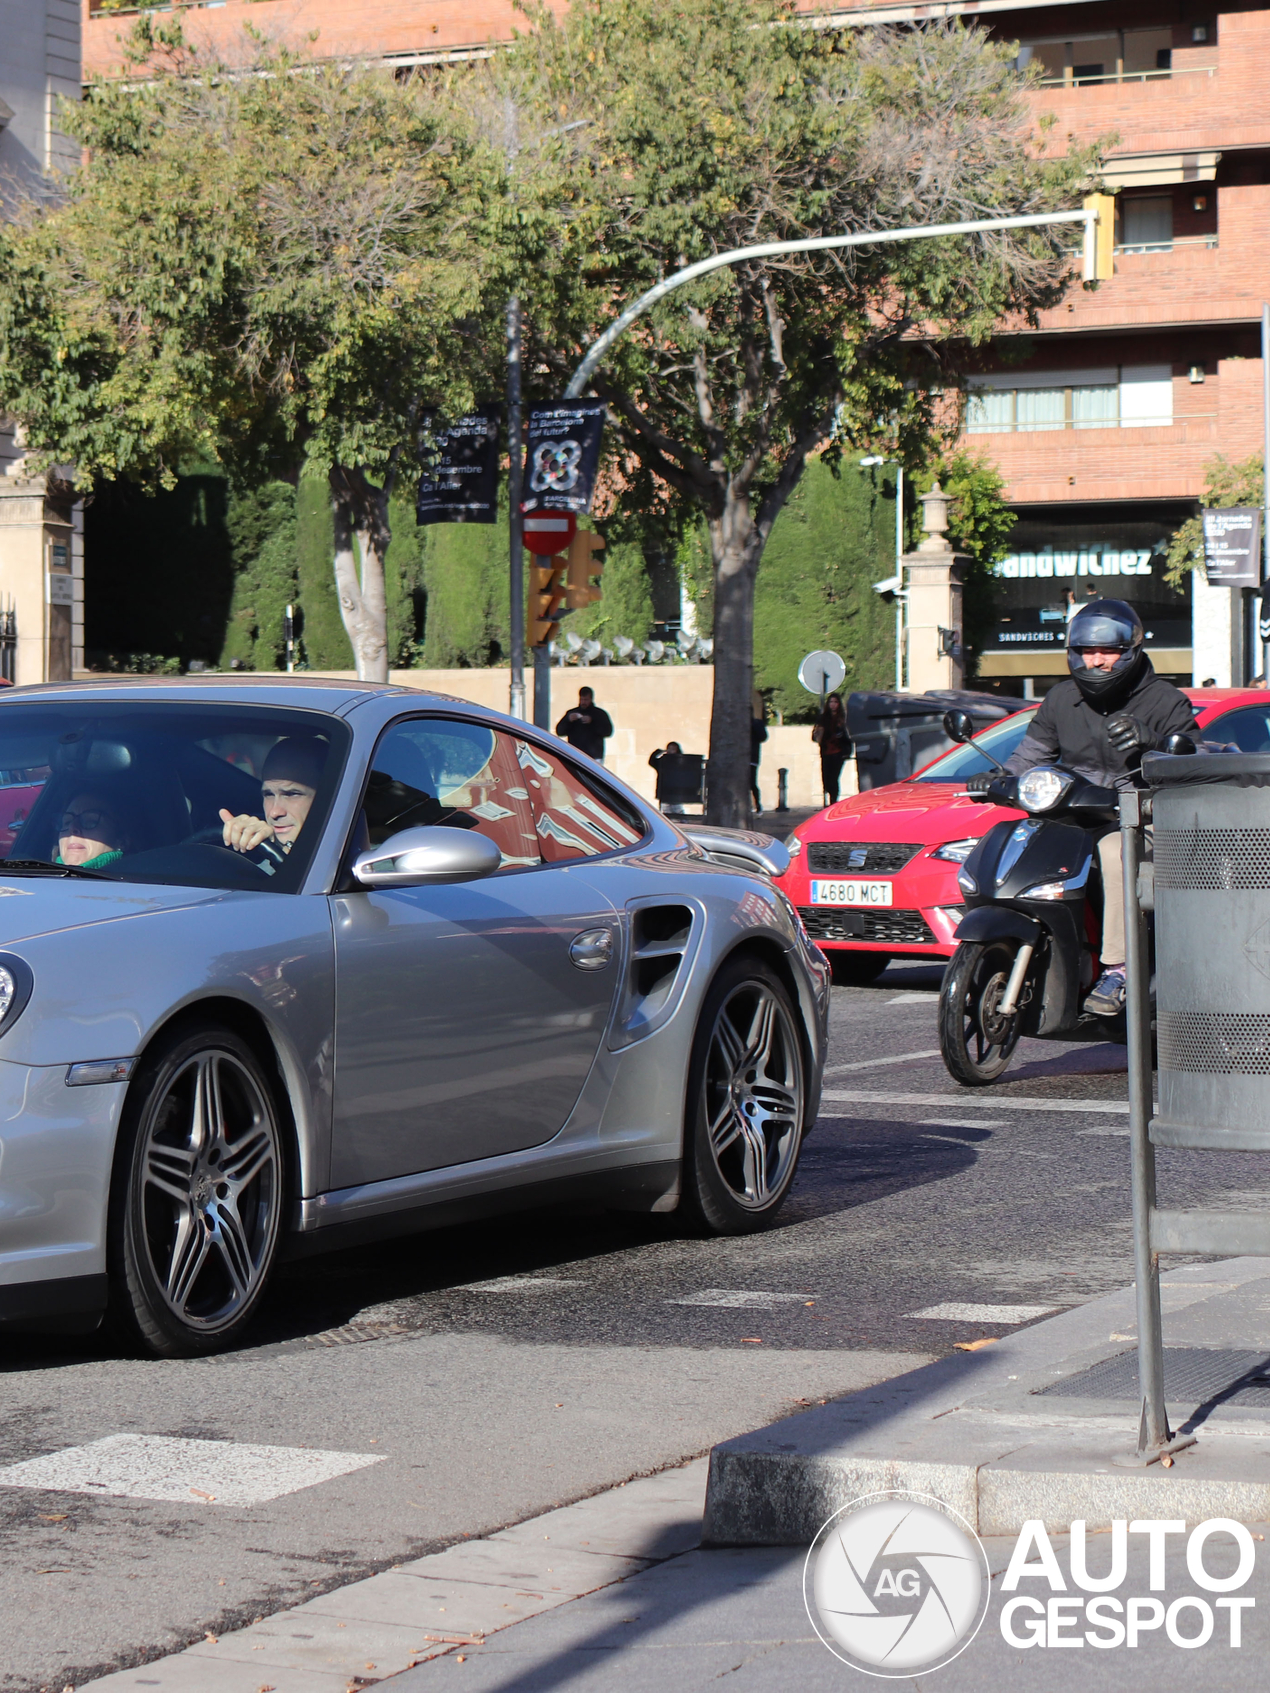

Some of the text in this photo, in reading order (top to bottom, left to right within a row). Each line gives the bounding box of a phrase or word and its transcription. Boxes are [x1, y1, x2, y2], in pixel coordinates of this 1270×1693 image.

[539, 418, 585, 428] Barcelona
[435, 465, 483, 474] desembre
[1216, 514, 1252, 523] Jornades
[993, 544, 1153, 578] andwiChez
[998, 631, 1054, 642] SANDWICHES
[821, 884, 888, 903] 4680 MCT
